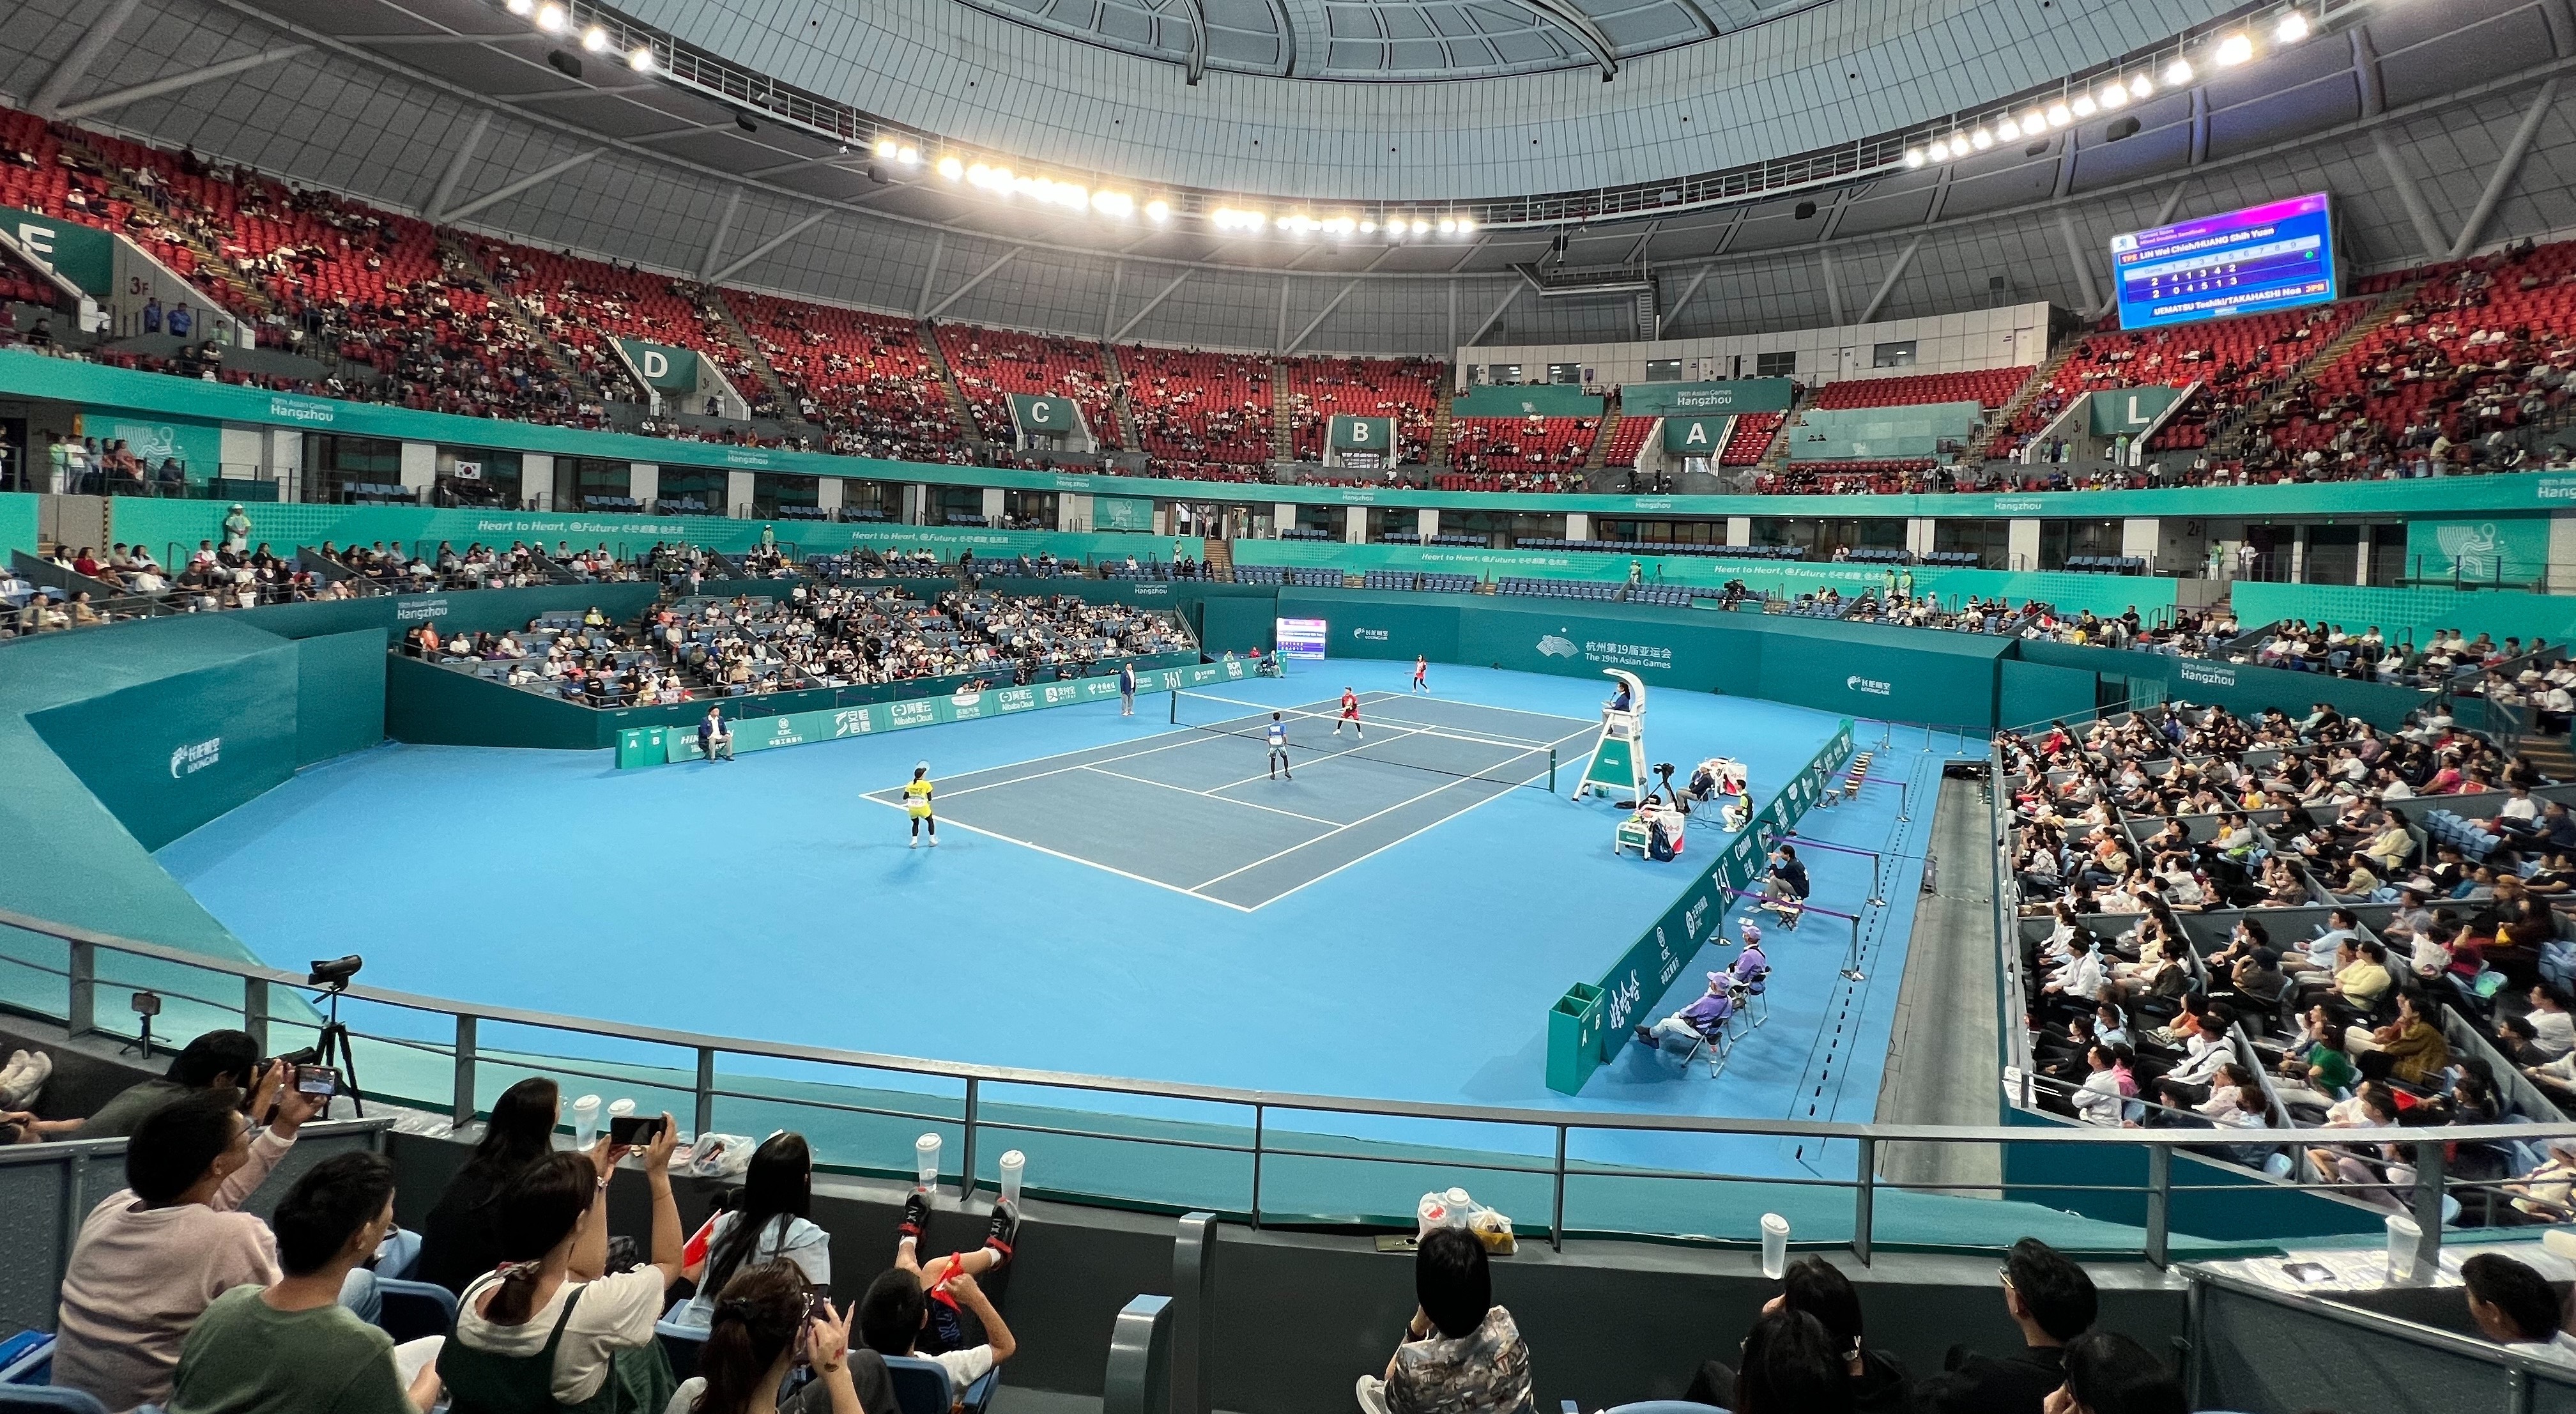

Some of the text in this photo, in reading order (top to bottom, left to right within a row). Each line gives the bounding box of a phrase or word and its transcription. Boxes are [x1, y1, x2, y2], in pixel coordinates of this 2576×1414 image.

[19, 223, 55, 275] E
[2140, 250, 2154, 259] LIN
[2230, 231, 2250, 242] Shih
[2251, 228, 2275, 238] Yuan
[2151, 277, 2159, 286] 2
[2172, 273, 2179, 282] 4
[2214, 266, 2221, 275] 4
[130, 277, 149, 295] 3F
[2152, 277, 2237, 298] 2 0 4 5 1 3
[2154, 303, 2195, 316] UEMATSU
[2282, 287, 2301, 296] Noa
[645, 351, 668, 378] D
[1678, 396, 1732, 406] Hangzhou
[271, 404, 334, 422] Hangzhou
[1032, 402, 1049, 423] C
[2128, 396, 2150, 424] L
[1353, 422, 1368, 442] B
[1686, 423, 1707, 445] A
[728, 454, 768, 465] Hangzhou
[1056, 480, 1089, 488] Hangzhou
[1994, 502, 2041, 511] Hangzhou
[479, 520, 512, 530] Heart
[516, 521, 529, 530] to
[570, 522, 618, 533] @Future
[852, 532, 878, 540] Heart
[919, 533, 957, 542] @Future
[1714, 565, 1740, 574] Heart
[1784, 567, 1826, 578] @Future
[397, 607, 447, 620] Hangzhou
[1586, 641, 1672, 659] 杭州第19届亚运会
[1585, 653, 1671, 669] The 19th Asian Games
[1163, 669, 1182, 689] 361°
[1228, 668, 1243, 677] NAN
[2181, 668, 2235, 686] Hangzhou
[1012, 689, 1032, 700] 阿里云
[907, 701, 931, 714] 阿里云
[894, 713, 933, 726] Alibaba Cloud
[629, 739, 638, 749] A
[652, 737, 661, 745] B
[1595, 1013, 1600, 1030] B
[1582, 1029, 1588, 1047] A
